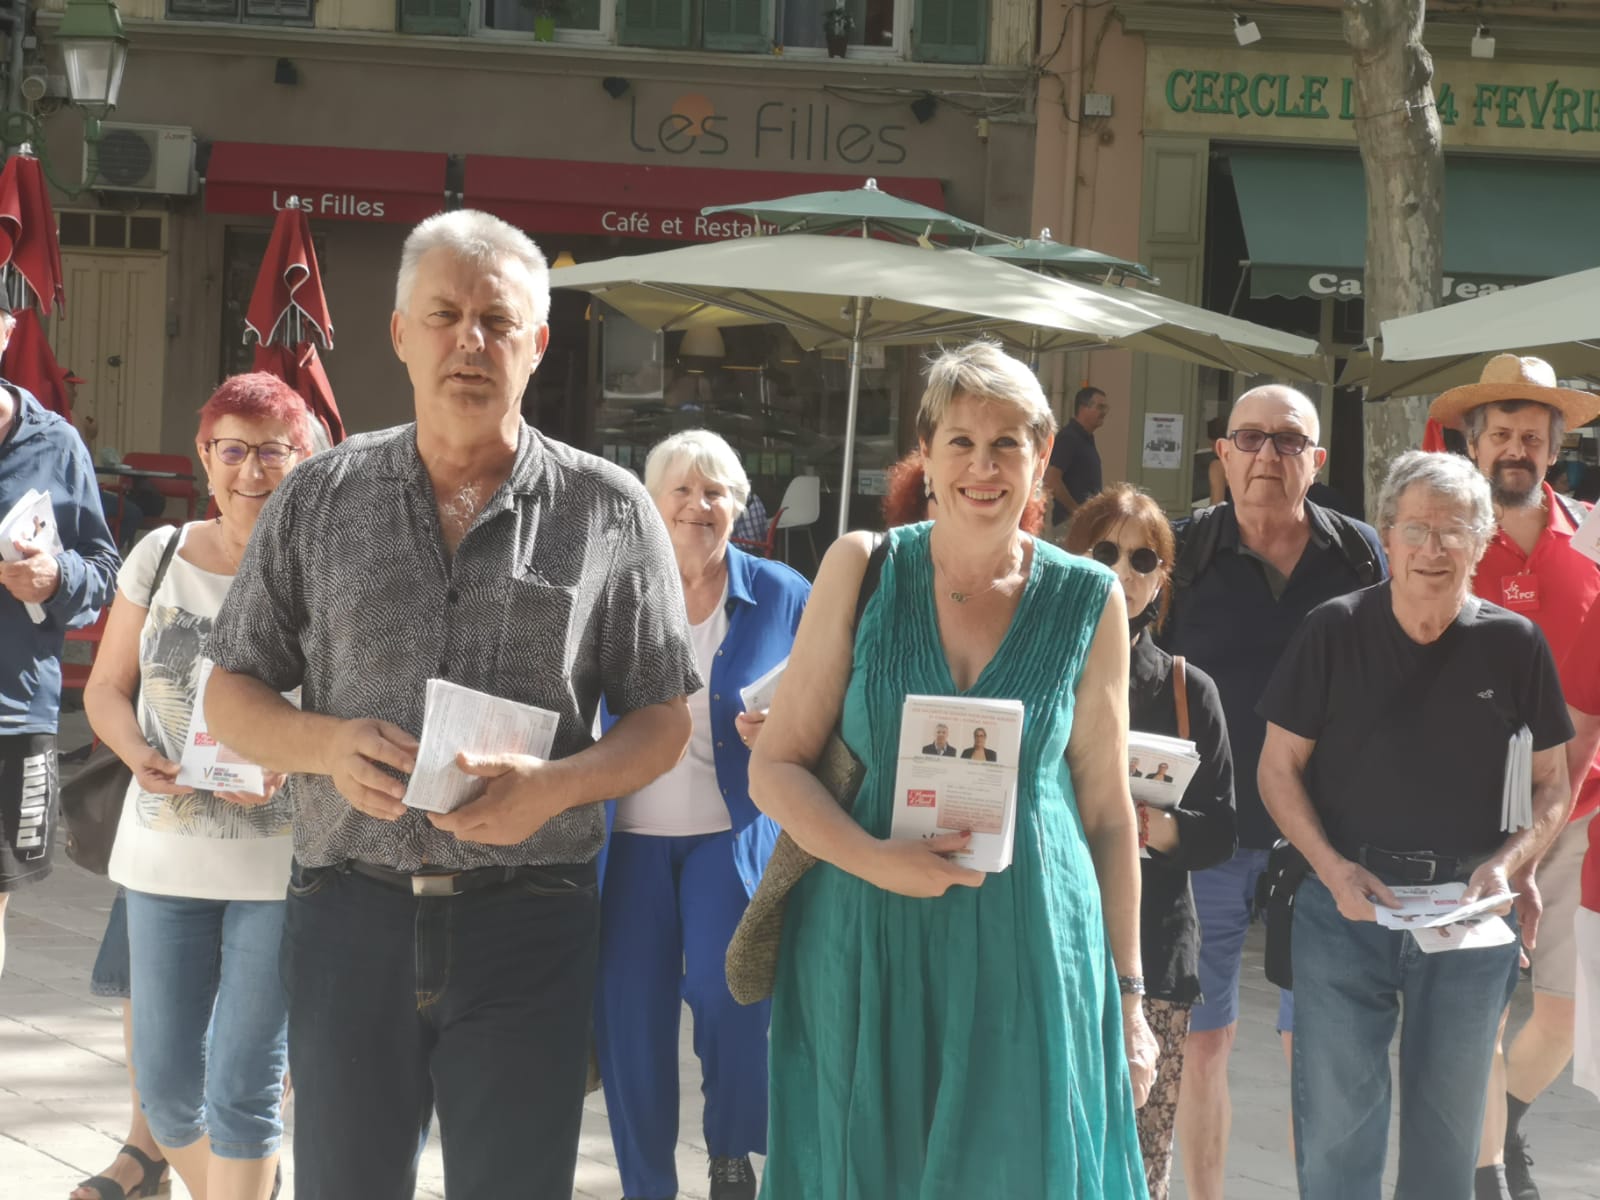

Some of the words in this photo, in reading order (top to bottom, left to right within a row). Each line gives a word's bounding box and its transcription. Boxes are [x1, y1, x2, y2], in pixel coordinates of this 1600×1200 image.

[1165, 69, 1329, 119] CERCLE
[630, 95, 729, 155] Les
[754, 101, 907, 164] Filles
[320, 193, 385, 217] Filles
[601, 211, 650, 233] Café
[661, 216, 683, 235] et
[16, 753, 47, 847] PUMA
